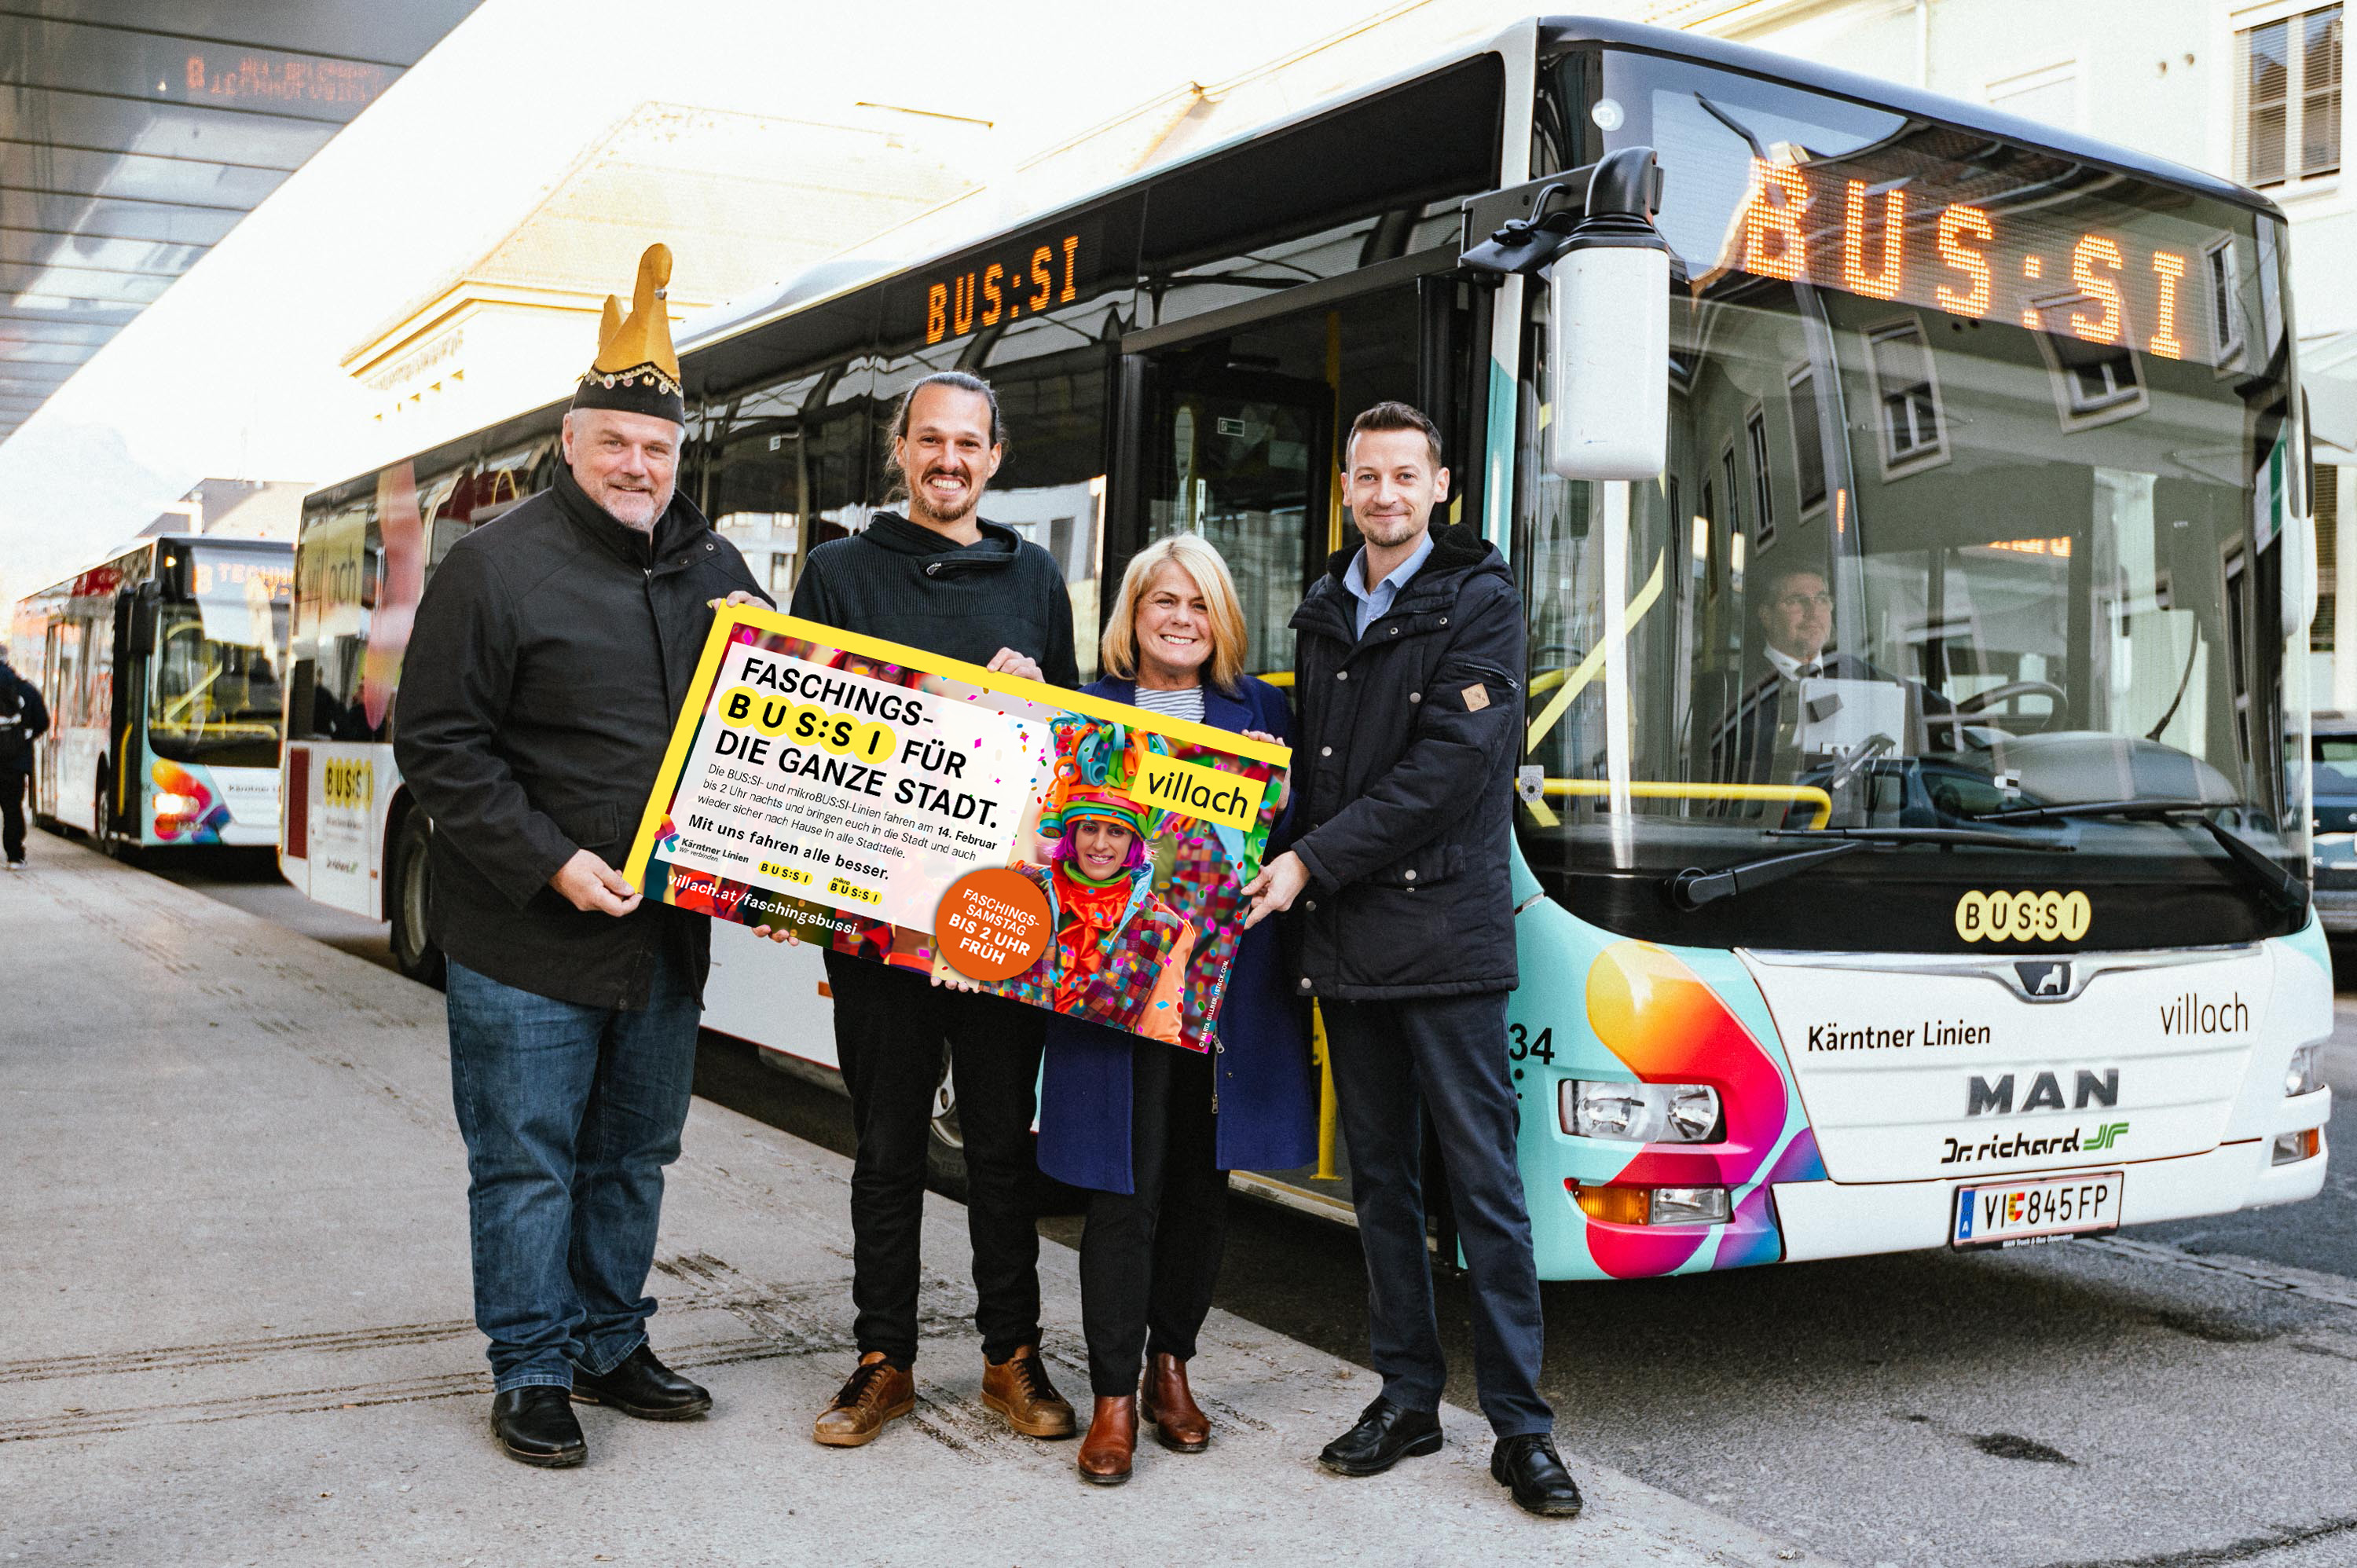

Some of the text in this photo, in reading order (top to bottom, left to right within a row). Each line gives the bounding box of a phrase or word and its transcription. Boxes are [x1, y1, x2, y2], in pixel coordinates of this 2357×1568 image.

[1745, 156, 2187, 361] BUS:SI
[926, 235, 1080, 345] BUS:SI
[741, 657, 933, 726] FASCHINGS-
[728, 693, 966, 779] BUS:SI FÜR
[327, 767, 371, 802] BUS:SI
[715, 729, 998, 828] DIE GANZE STADT.
[1149, 771, 1248, 818] villach
[698, 794, 905, 859] wieder sicher nach Hause in alle Stadtteile.
[702, 779, 976, 861] bis 2 Uhr nachts und bringen euch in die Stadt und auch
[708, 764, 997, 850] Die BUS:SI- und mikroBUS:SI-Linien fahren am 14. Februar
[681, 838, 750, 863] Kärntner Linien
[688, 814, 889, 880] Mit uns fahren alle besser.
[761, 863, 808, 883] BUS:SI
[830, 882, 878, 902] BUS:SI
[669, 874, 858, 935] villach.at/faschingsbussi
[962, 888, 1039, 926] FASCHINGS-
[966, 904, 1026, 936] SAMSTAG
[1966, 903, 2077, 930] BUS:SI
[948, 913, 1031, 956] BIS 2 UHR
[959, 937, 1006, 965] FRÜH
[1200, 1022, 1211, 1042] MARTA
[2161, 991, 2249, 1035] villach
[1508, 1023, 1555, 1065] 34
[1808, 1020, 1991, 1052] Kärntner Linien
[1967, 1068, 2119, 1116] MAN
[1961, 1220, 1969, 1233] A
[1985, 1193, 2007, 1229] VI
